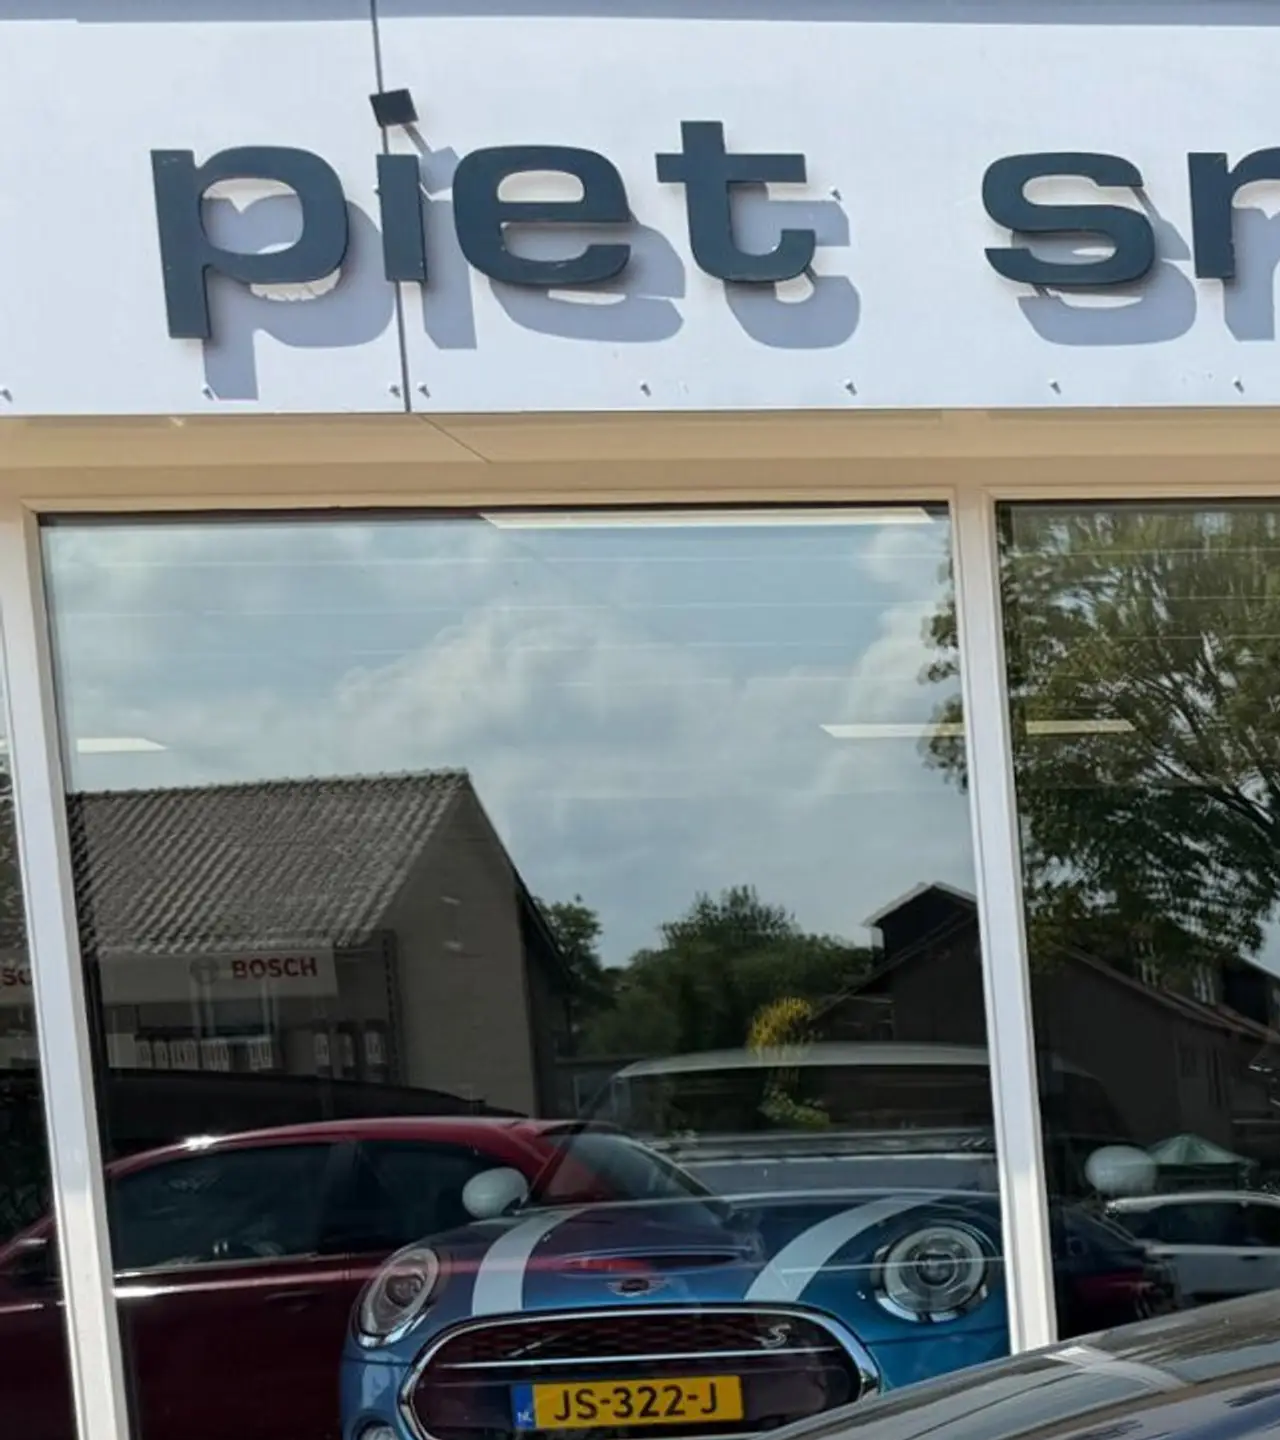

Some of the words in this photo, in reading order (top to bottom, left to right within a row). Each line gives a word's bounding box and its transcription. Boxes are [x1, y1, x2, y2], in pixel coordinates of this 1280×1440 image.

[150, 88, 817, 340] piet
[231, 956, 319, 981] BOSCH
[553, 1382, 718, 1421] JS-322-J
